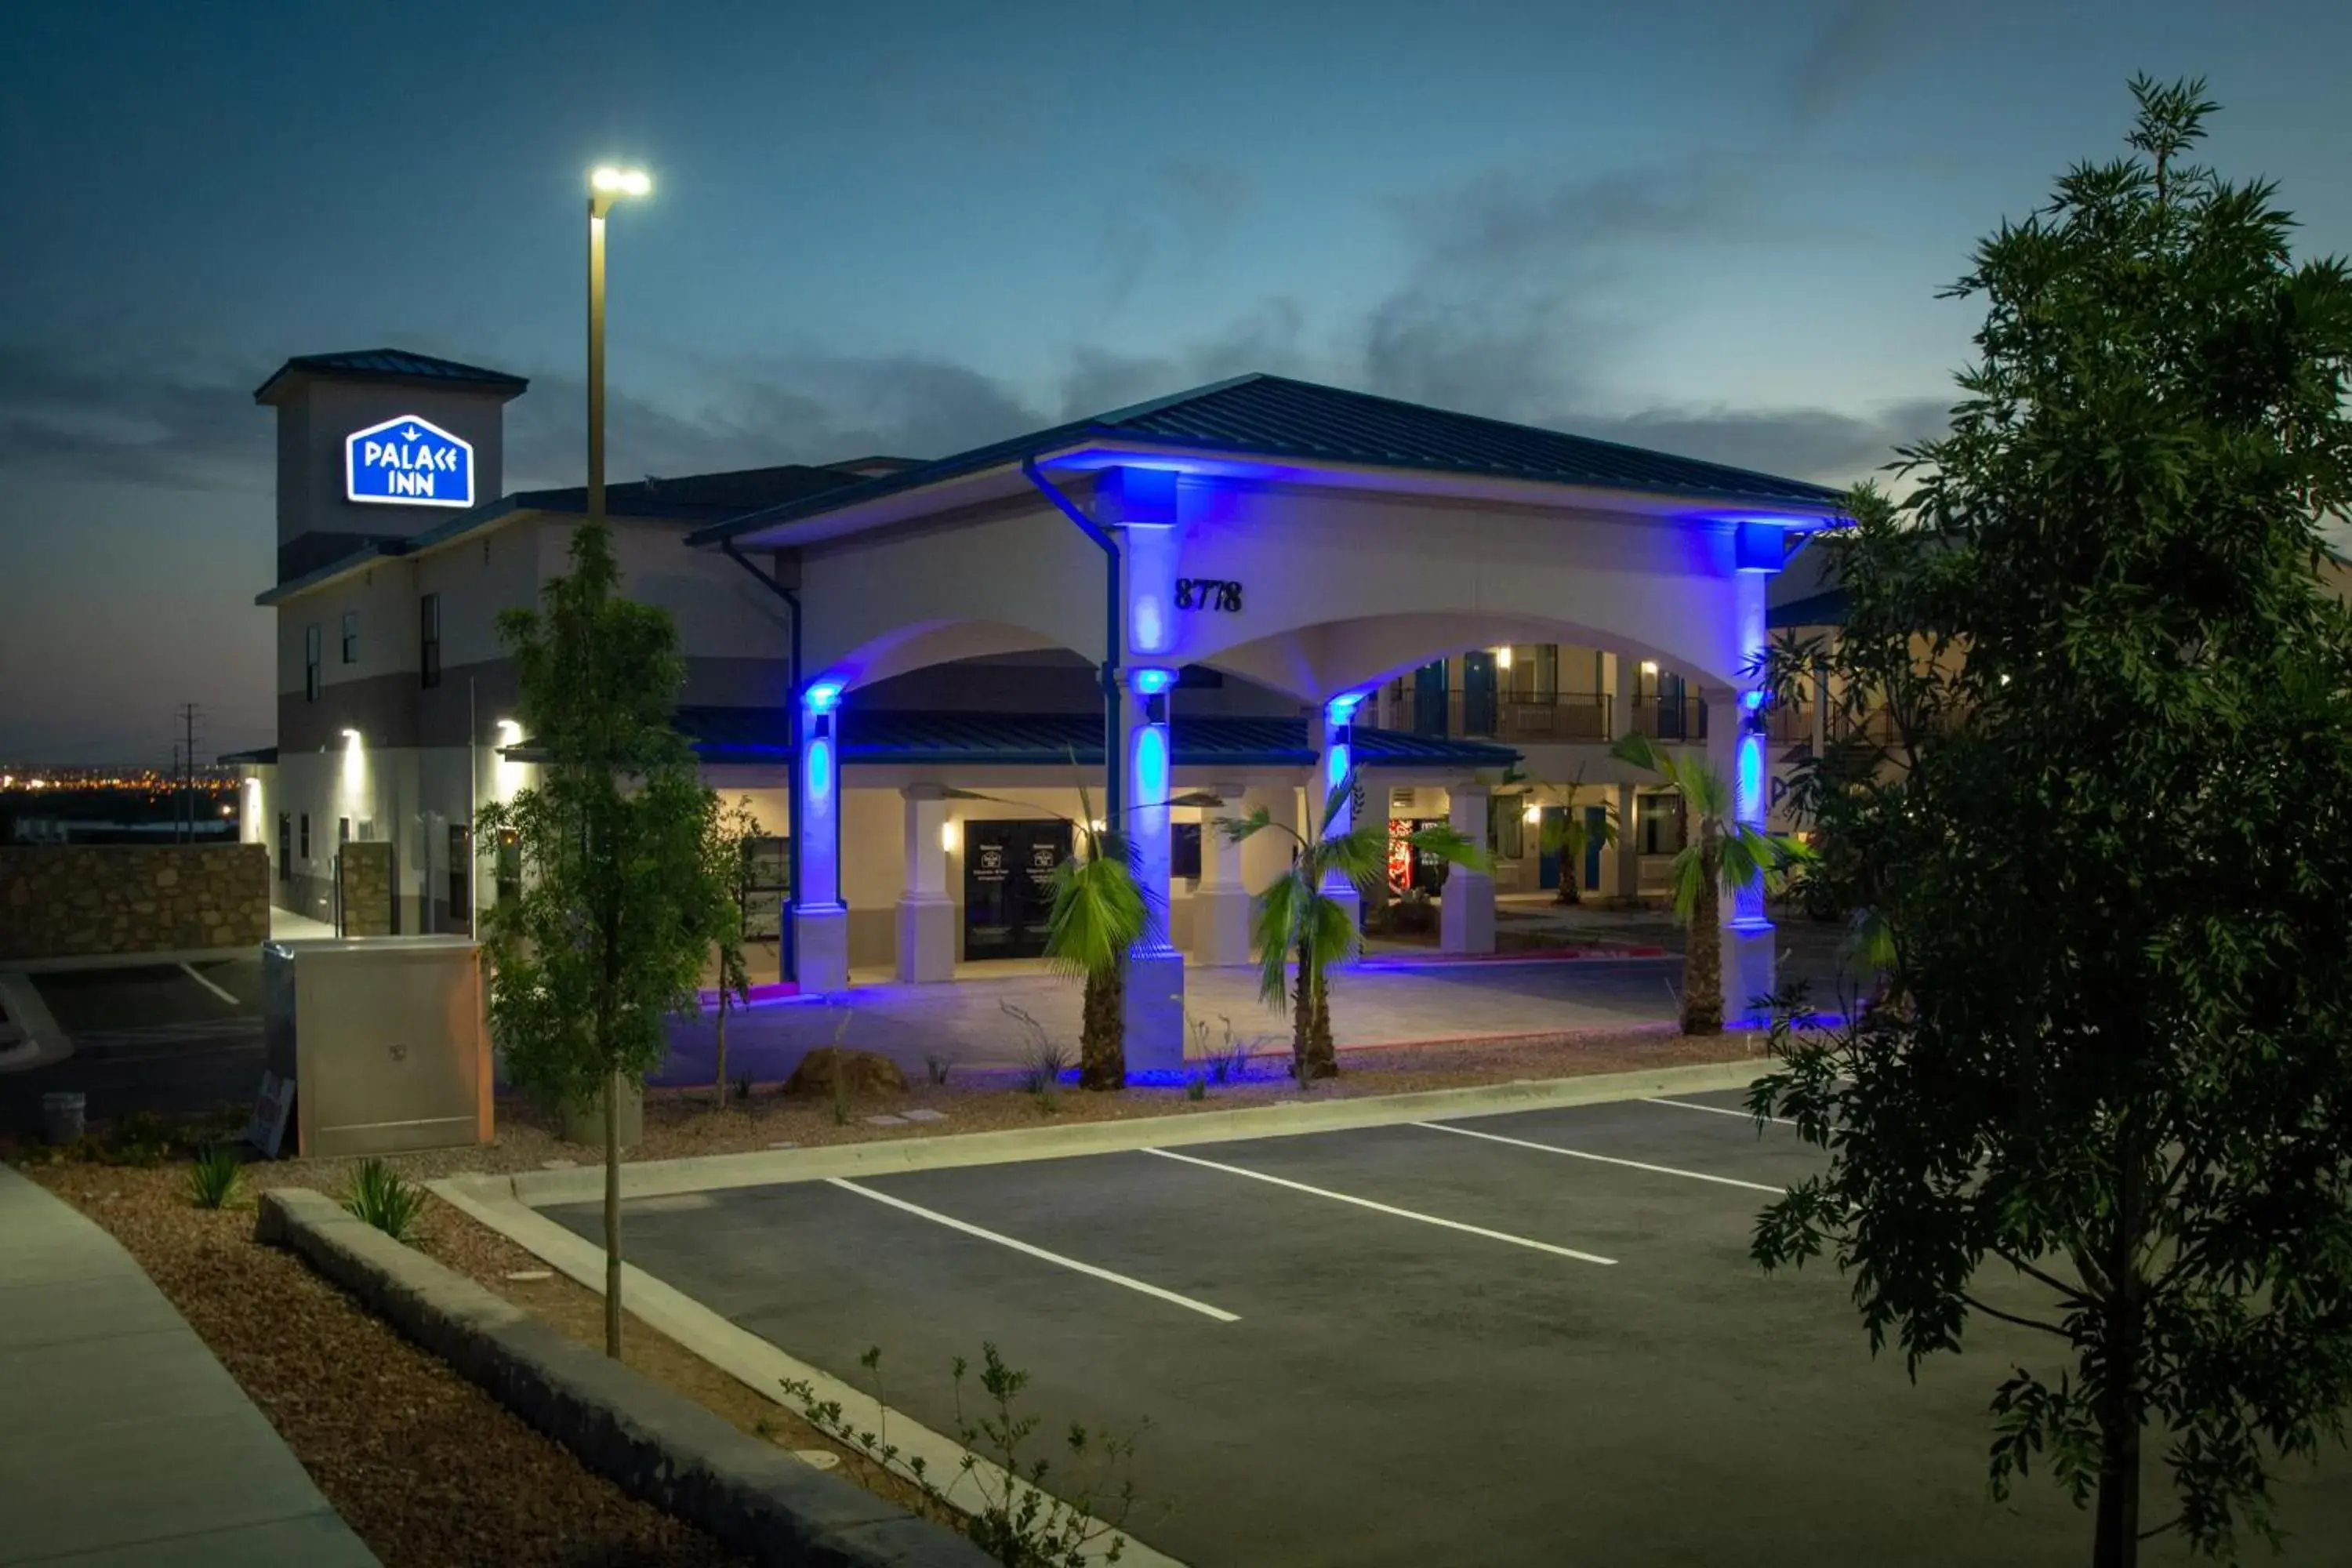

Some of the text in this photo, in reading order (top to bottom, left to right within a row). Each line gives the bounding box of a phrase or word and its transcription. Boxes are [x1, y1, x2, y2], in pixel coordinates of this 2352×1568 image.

[365, 441, 457, 472] PALACE
[389, 470, 434, 497] INN
[1175, 578, 1242, 612] 8778
